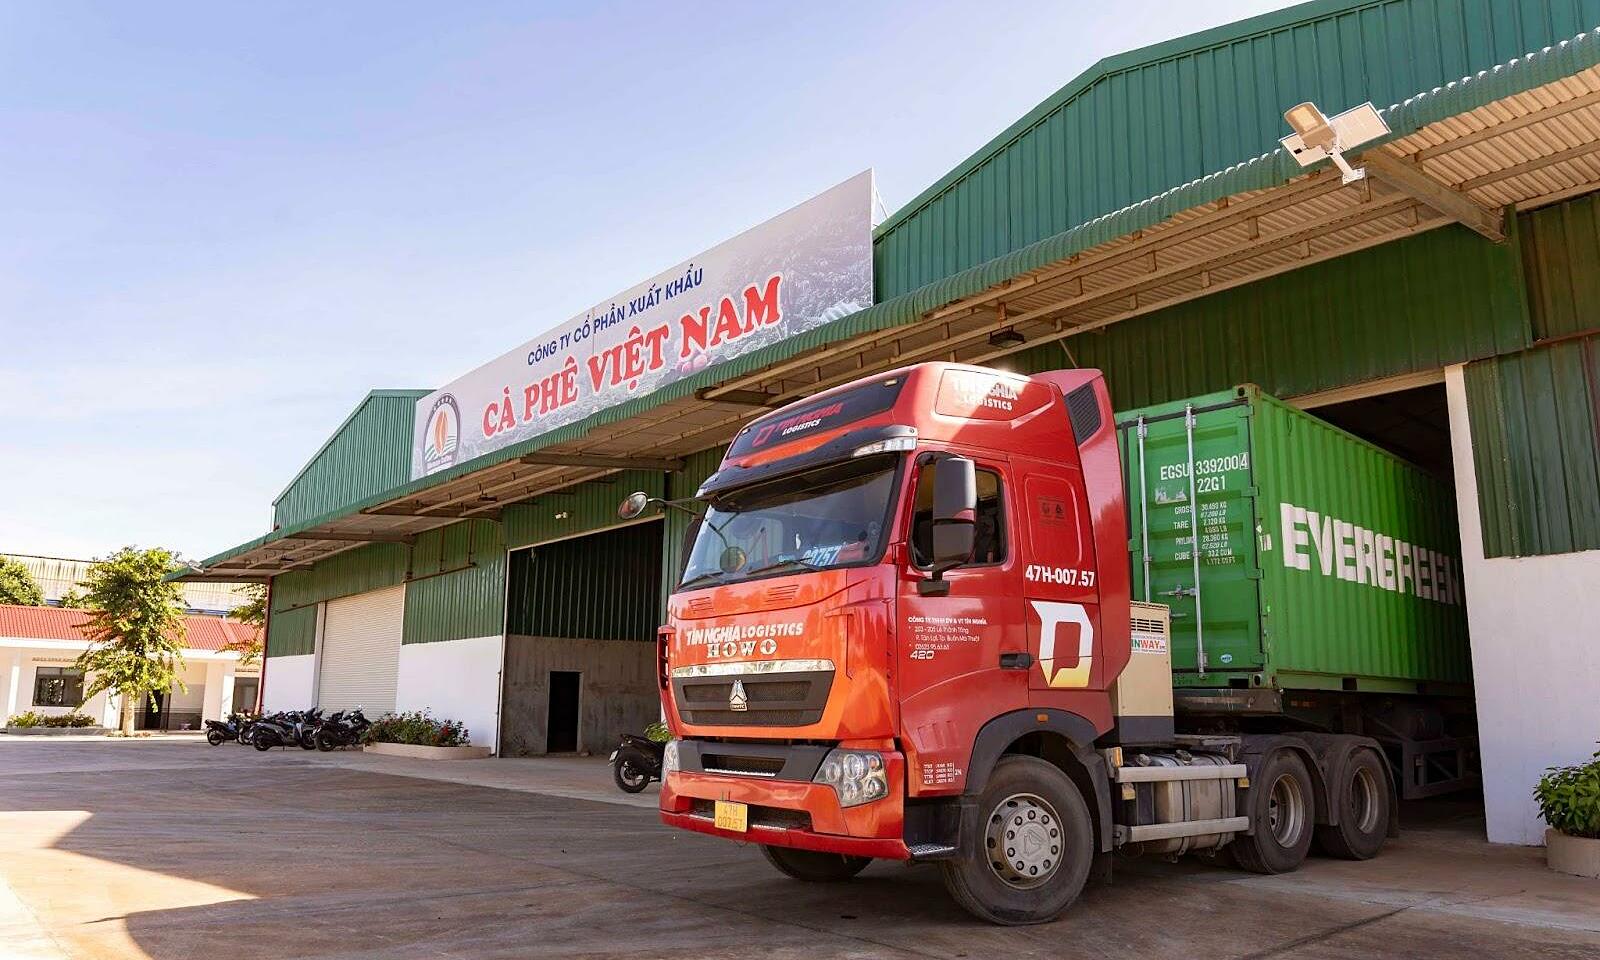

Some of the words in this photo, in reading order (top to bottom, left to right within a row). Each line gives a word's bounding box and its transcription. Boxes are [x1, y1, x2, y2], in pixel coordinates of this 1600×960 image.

[528, 343, 557, 366] CÔNG
[560, 332, 572, 352] TY
[574, 314, 591, 344] CỔ
[594, 303, 625, 335] PHẦN
[629, 283, 662, 318] XUẤT
[666, 263, 703, 301] KHẨU
[483, 386, 516, 438] CÀ
[524, 356, 578, 423] PHÊ
[587, 325, 669, 391] VIỆT
[681, 275, 782, 359] NAM
[782, 418, 821, 436] LOGISTICS
[1160, 463, 1190, 481] EGSU
[1197, 475, 1226, 493] 22G1
[1173, 520, 1189, 530] TARE
[1174, 551, 1191, 561] CUBE
[1279, 502, 1461, 607] EVERGREEN
[1025, 564, 1095, 588] 47H-007.57
[741, 622, 804, 638] LOGISTICS
[706, 638, 778, 659] HOWO
[910, 650, 934, 660] 420
